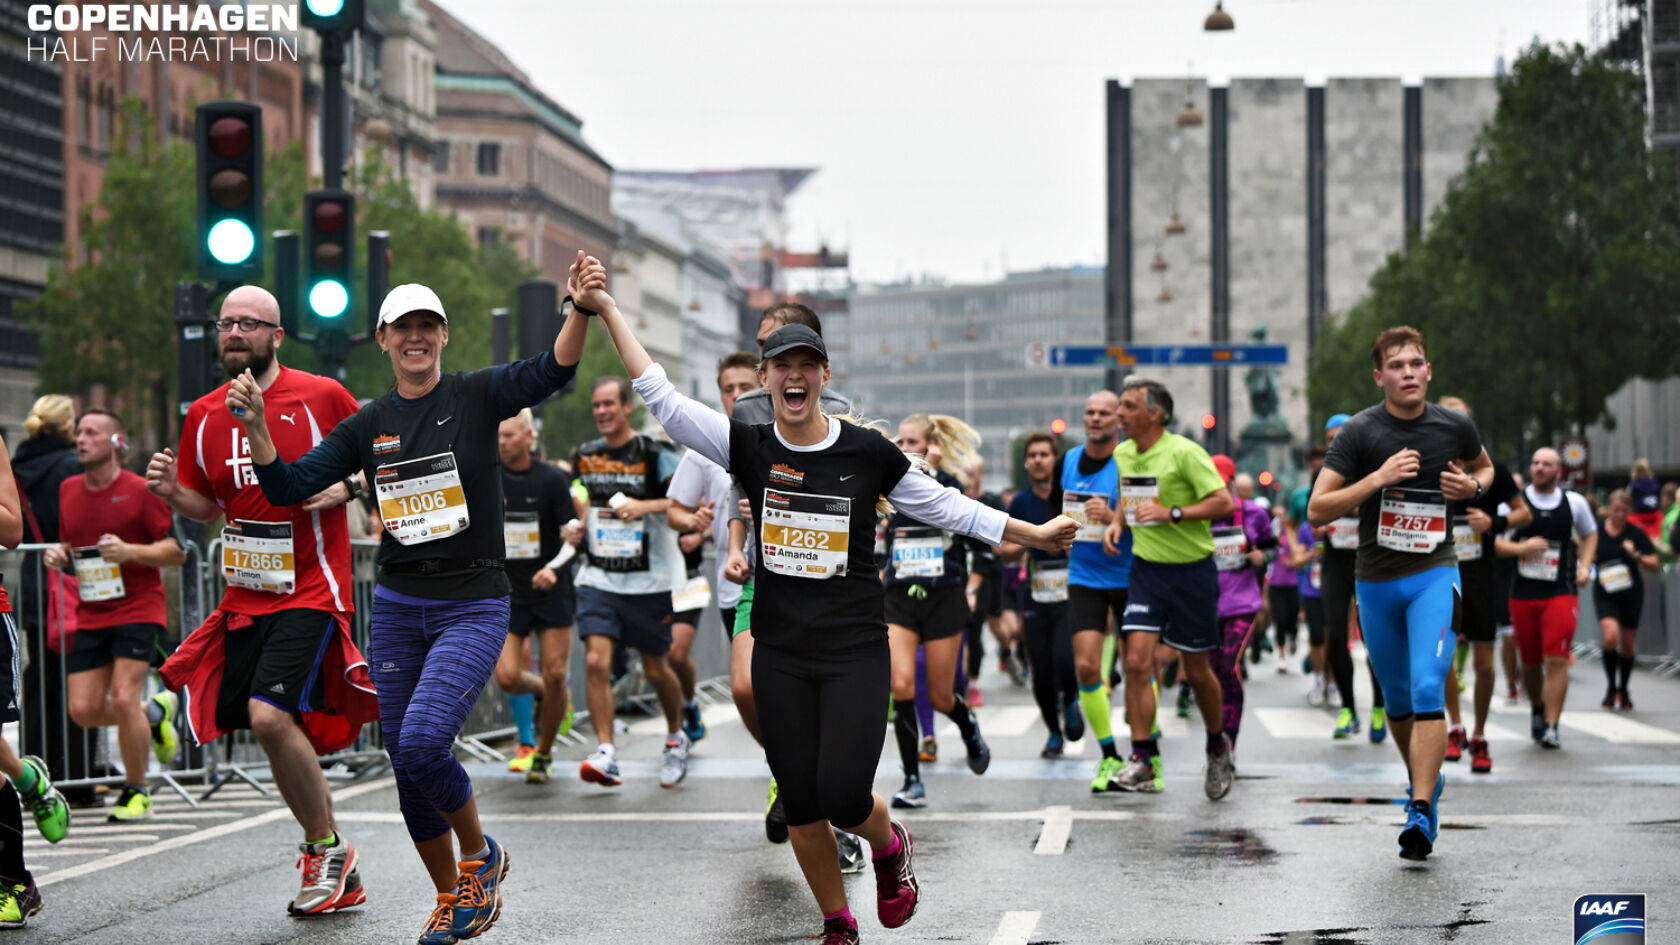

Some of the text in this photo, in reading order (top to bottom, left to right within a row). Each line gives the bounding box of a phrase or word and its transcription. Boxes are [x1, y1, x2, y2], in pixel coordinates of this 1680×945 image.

[398, 491, 446, 515] 1006
[400, 517, 425, 528] Anne
[1393, 514, 1432, 531] 2757
[780, 527, 829, 550] 1262
[1392, 529, 1428, 540] Benjamin
[232, 550, 284, 570] 17866
[777, 548, 818, 561] Amanda
[236, 569, 261, 579] Timon
